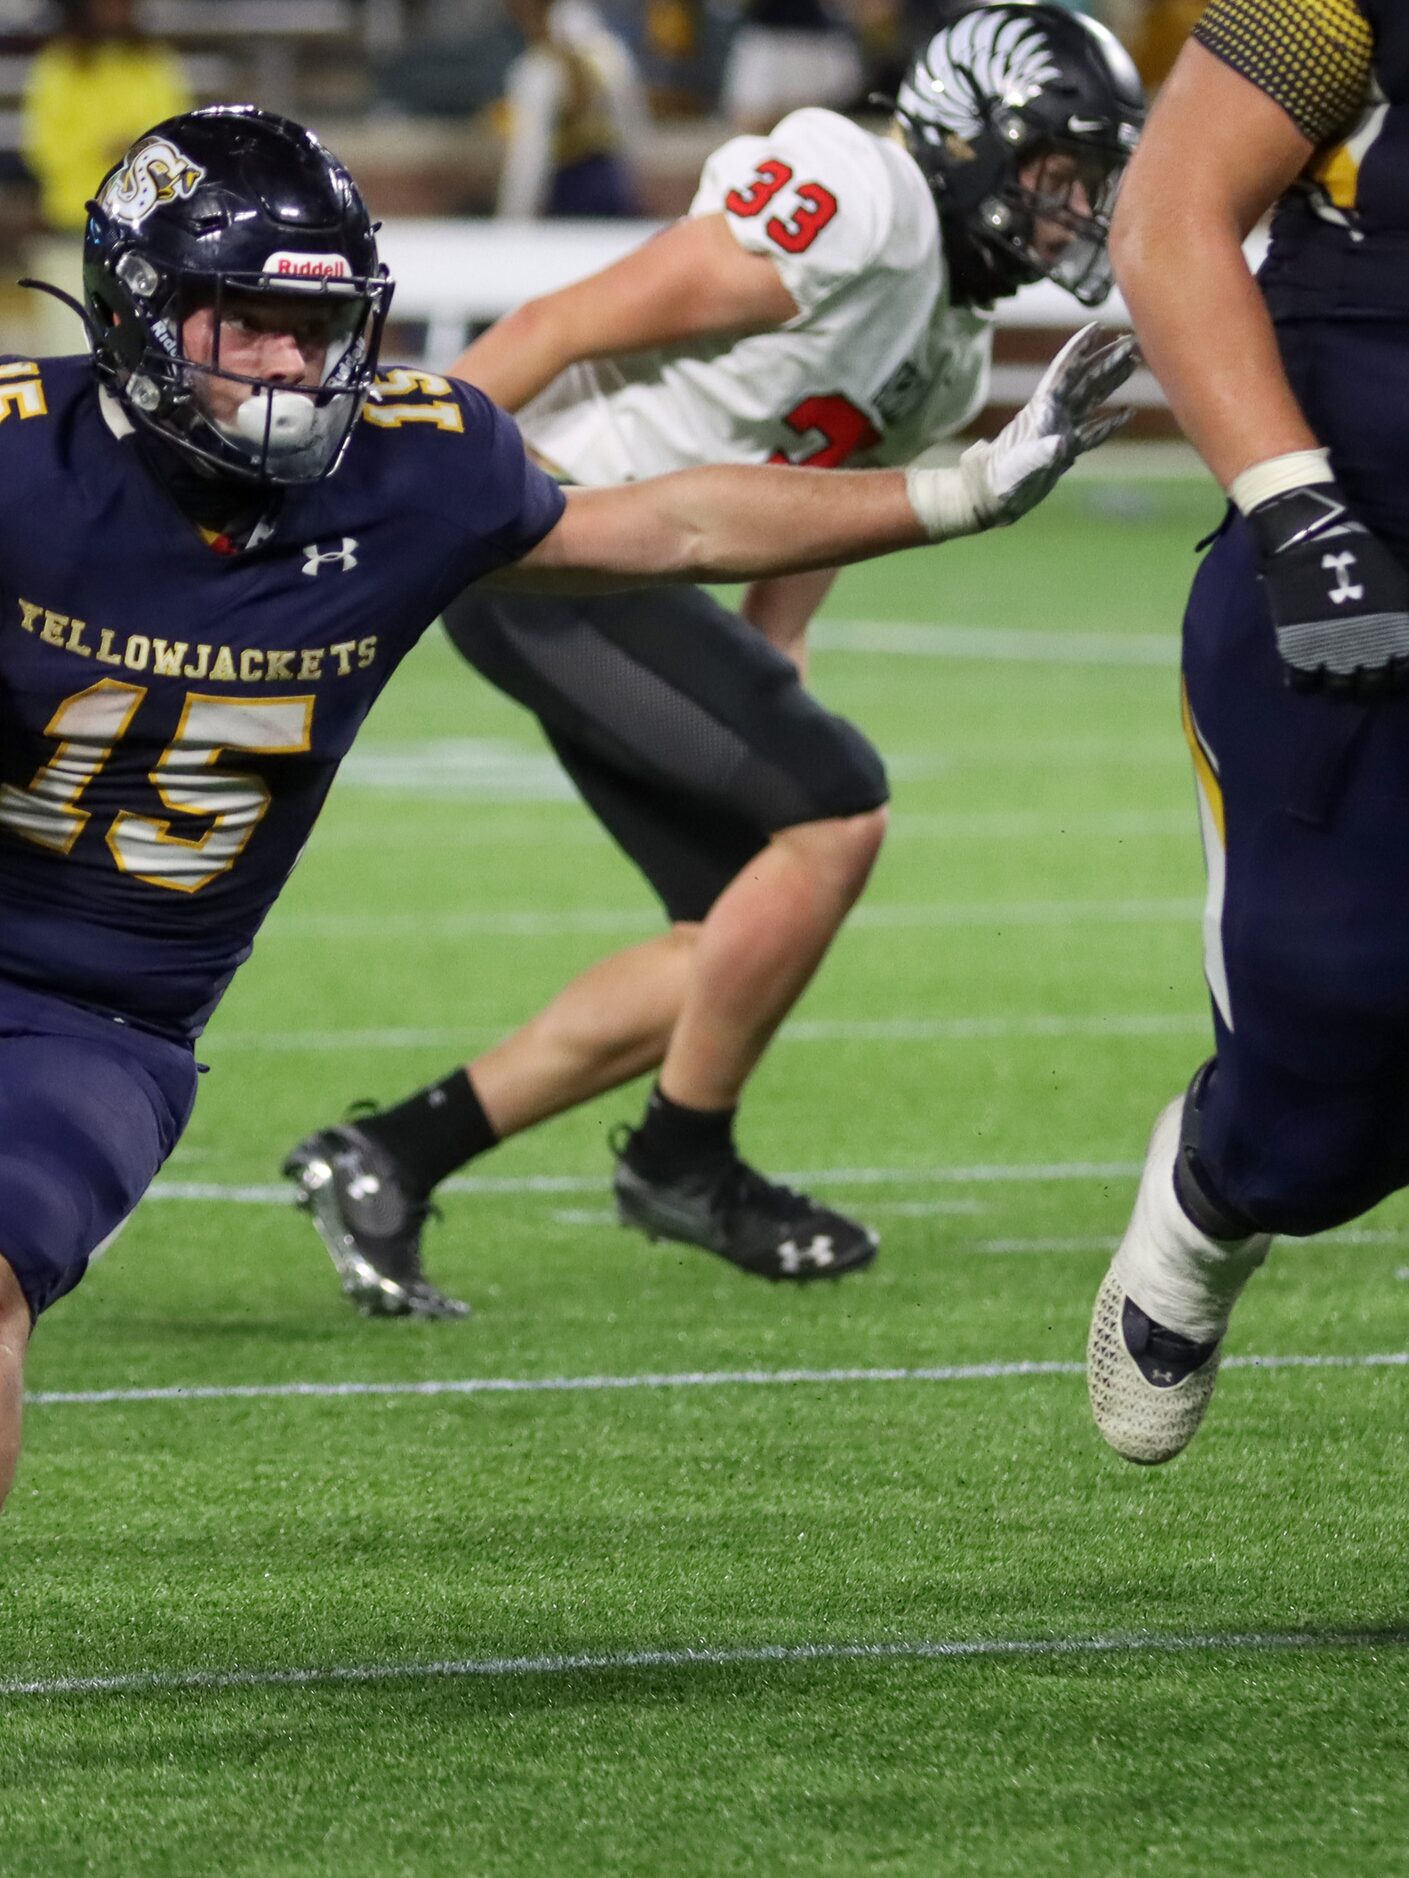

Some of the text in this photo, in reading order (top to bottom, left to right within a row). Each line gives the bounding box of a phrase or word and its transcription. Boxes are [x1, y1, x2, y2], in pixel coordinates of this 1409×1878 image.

[725, 159, 837, 254] 33
[278, 258, 344, 277] Riddell
[362, 367, 465, 434] 15
[18, 598, 379, 682] YELLOWJACKETS
